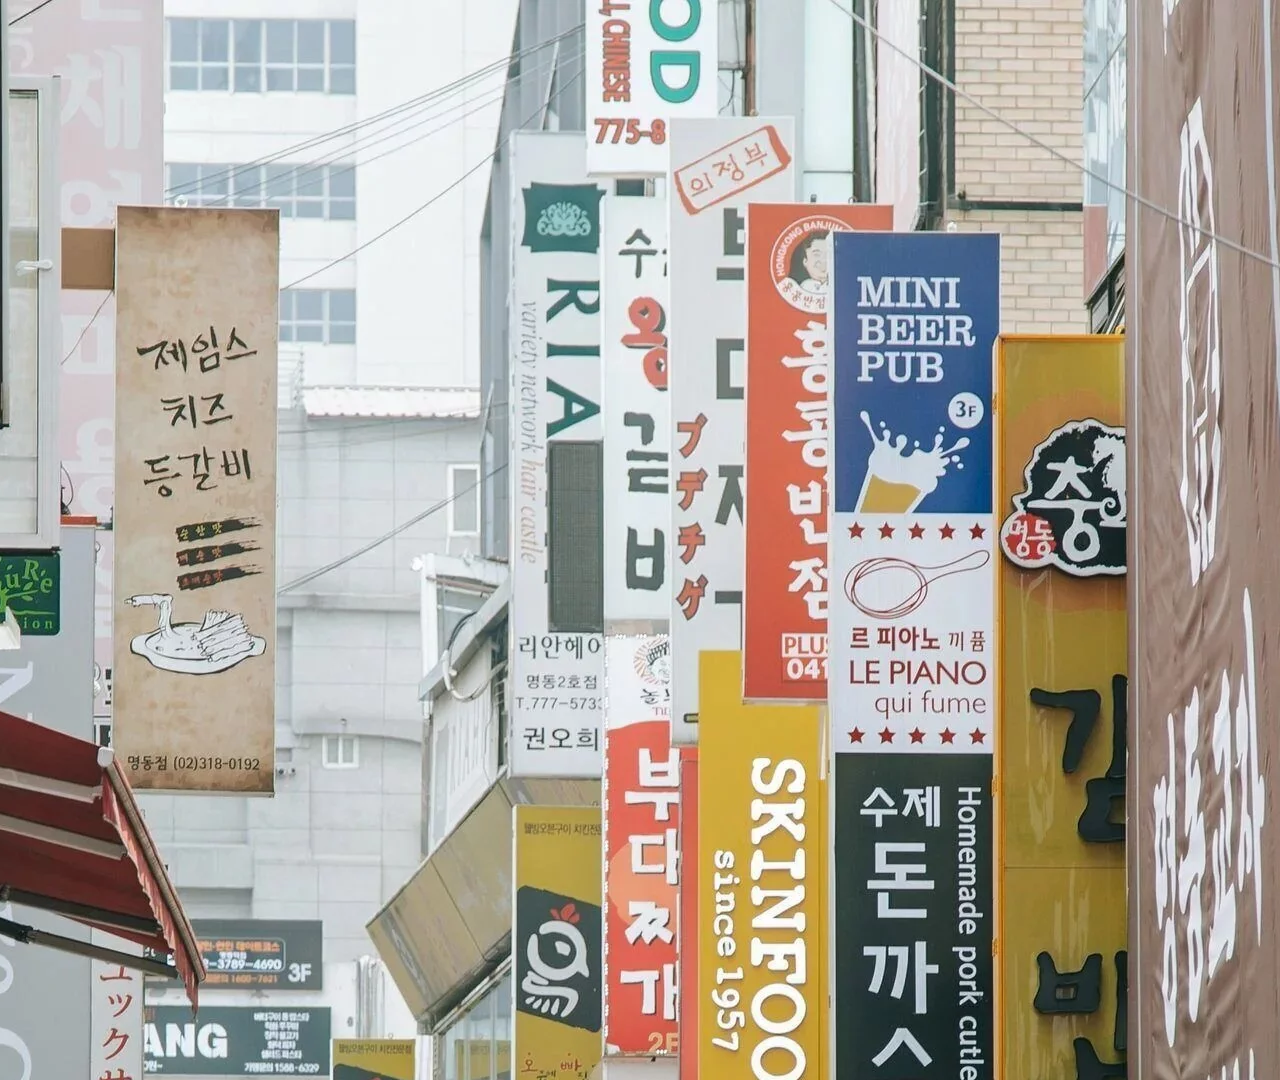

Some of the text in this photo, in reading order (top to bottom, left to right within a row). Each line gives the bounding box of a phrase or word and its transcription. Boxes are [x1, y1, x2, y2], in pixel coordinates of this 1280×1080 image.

[602, 19, 632, 103] CHINESE
[690, 142, 767, 197] 의정부
[857, 276, 961, 308] MINI
[857, 314, 976, 347] BEER
[136, 326, 257, 373] 제임스
[857, 352, 944, 383] PUB
[160, 393, 233, 428] 치즈
[955, 402, 977, 418] 3F
[520, 301, 545, 565] variety network hair castle
[143, 447, 252, 497] 등갈비
[1008, 517, 1055, 557] 명동
[850, 627, 986, 653] 르 피아노 끼 퓸
[526, 674, 598, 690] 명동2호점
[850, 660, 987, 685] LE PIANO
[875, 690, 987, 720] qui fume
[126, 755, 260, 772] 명동점 (02)318-0192
[860, 785, 940, 828] 수제
[956, 785, 982, 936] Homemade
[619, 747, 681, 1024] 부대찌개
[711, 849, 746, 1052] since 1957
[287, 962, 312, 983] 3F
[952, 945, 984, 1005] pork
